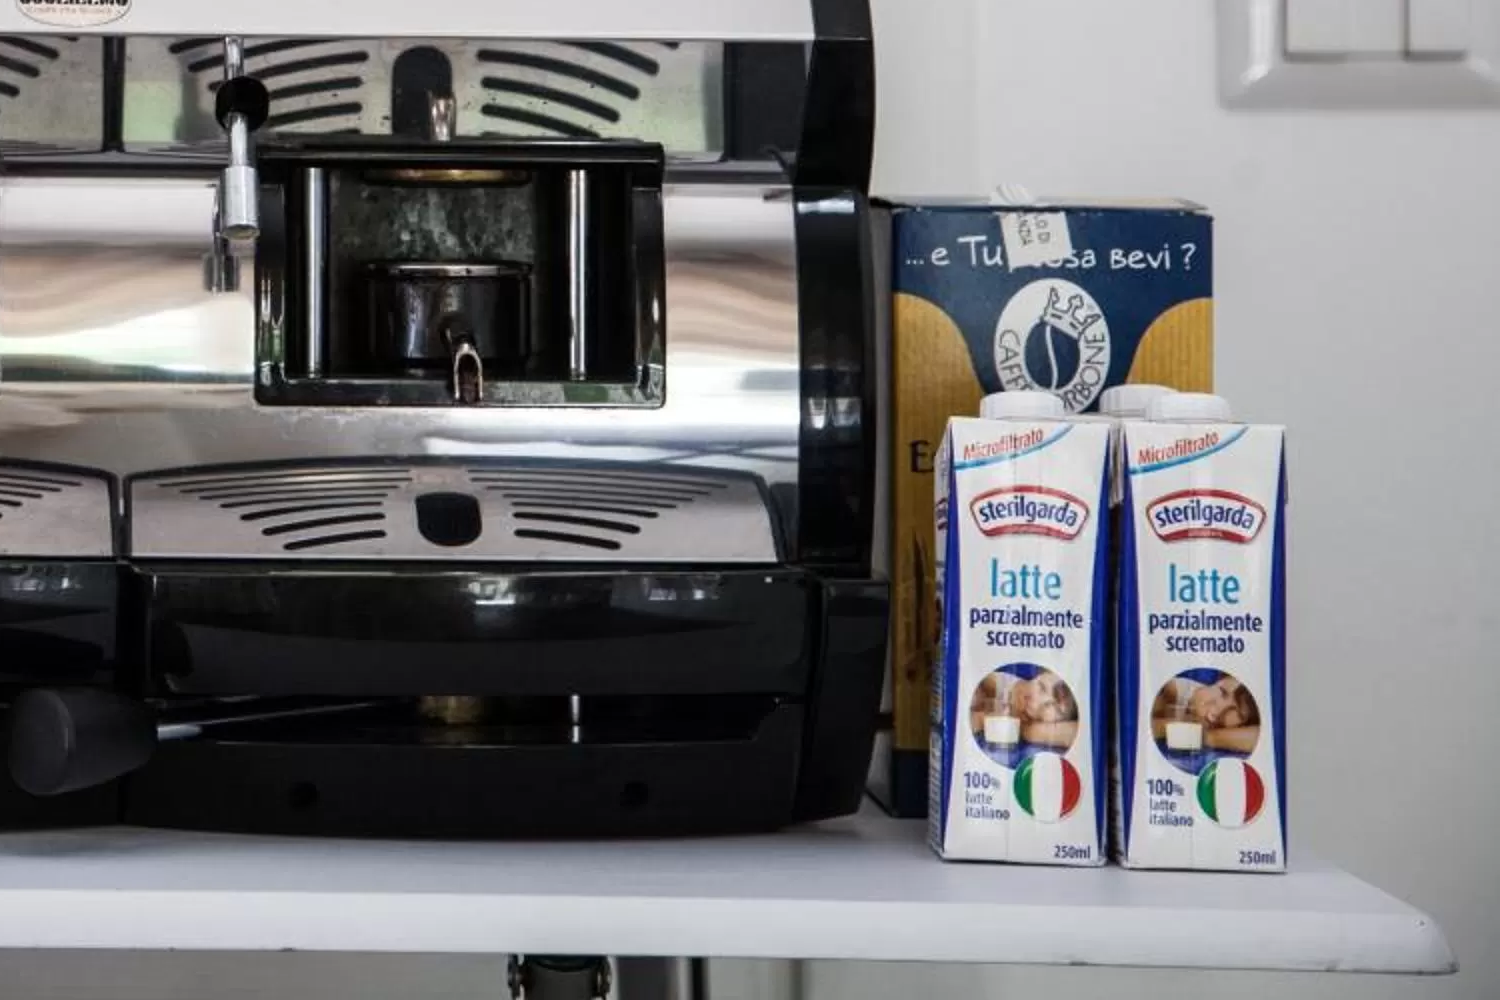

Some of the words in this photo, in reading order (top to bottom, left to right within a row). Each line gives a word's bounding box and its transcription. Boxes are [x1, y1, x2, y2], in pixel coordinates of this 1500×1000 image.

[957, 235, 1004, 268] Tu
[999, 329, 1035, 391] CAFF
[962, 427, 1045, 461] Microfiltrato
[1137, 431, 1220, 465] Microfiltrato
[979, 495, 1079, 527] sterilgarda
[1155, 498, 1255, 530] sterilgarda
[990, 557, 1062, 600] latte
[1169, 563, 1240, 604] latte
[969, 604, 1084, 628] parzialmente
[1148, 609, 1263, 634] parzialmente
[986, 630, 1066, 649] scremato
[1165, 634, 1245, 654] scremato
[964, 806, 1011, 821] italiano
[1148, 813, 1195, 827] italiano
[1054, 844, 1091, 859] 250ml
[1239, 850, 1277, 865] 250ml
